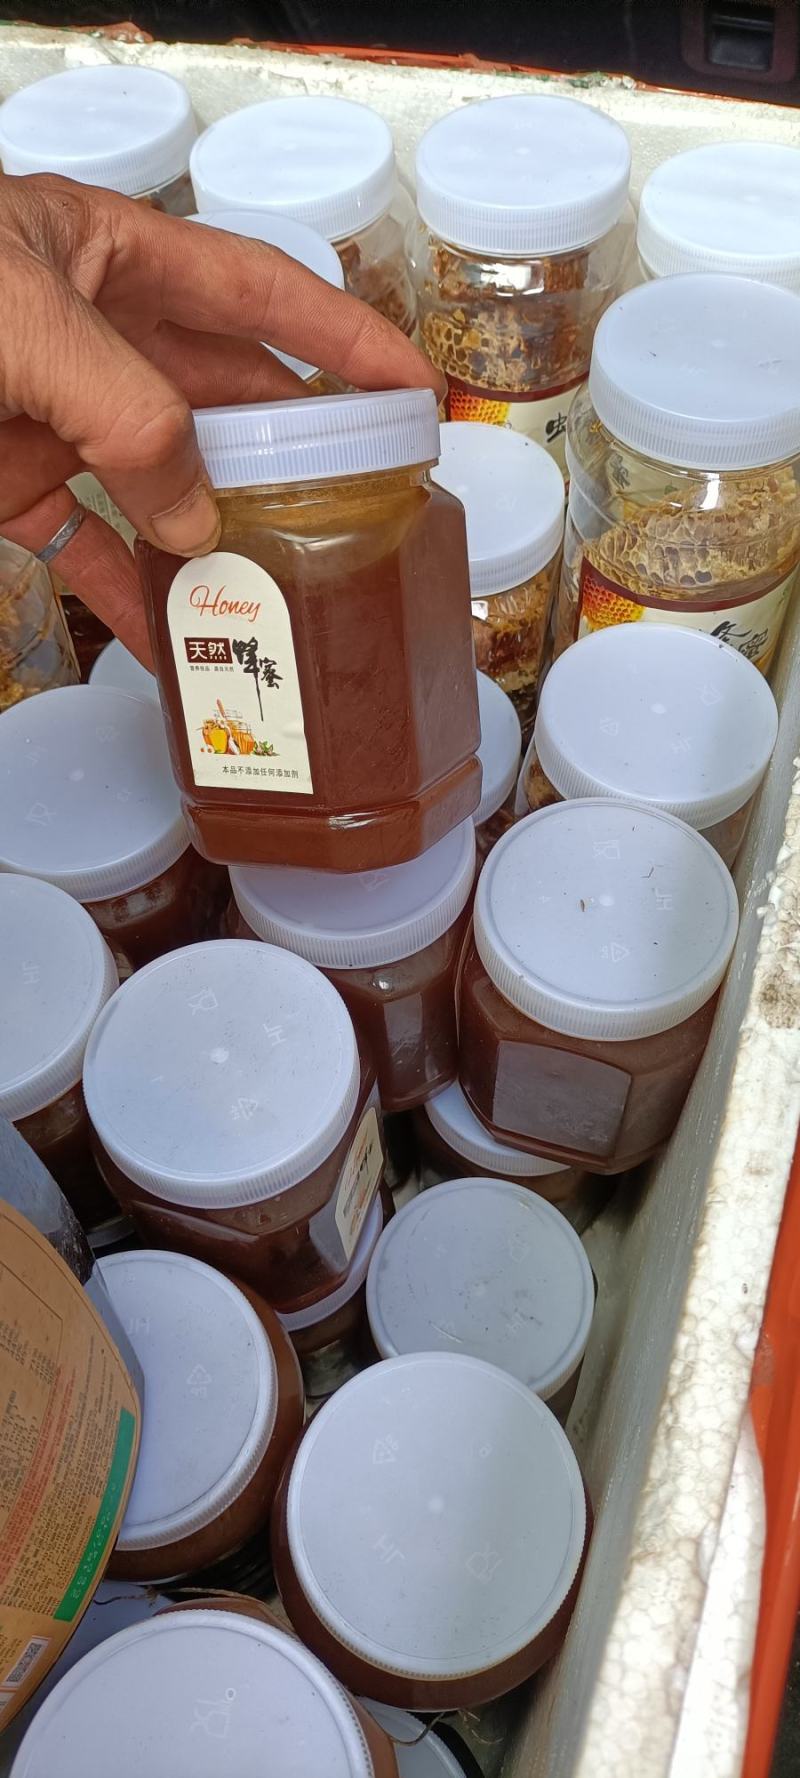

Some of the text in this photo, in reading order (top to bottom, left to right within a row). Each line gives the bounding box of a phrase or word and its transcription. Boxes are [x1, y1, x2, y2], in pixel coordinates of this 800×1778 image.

[189, 585, 262, 623] Honey
[188, 636, 283, 722] 天然 蜂蜜
[222, 764, 299, 779] 本品不添加任何添加剂
